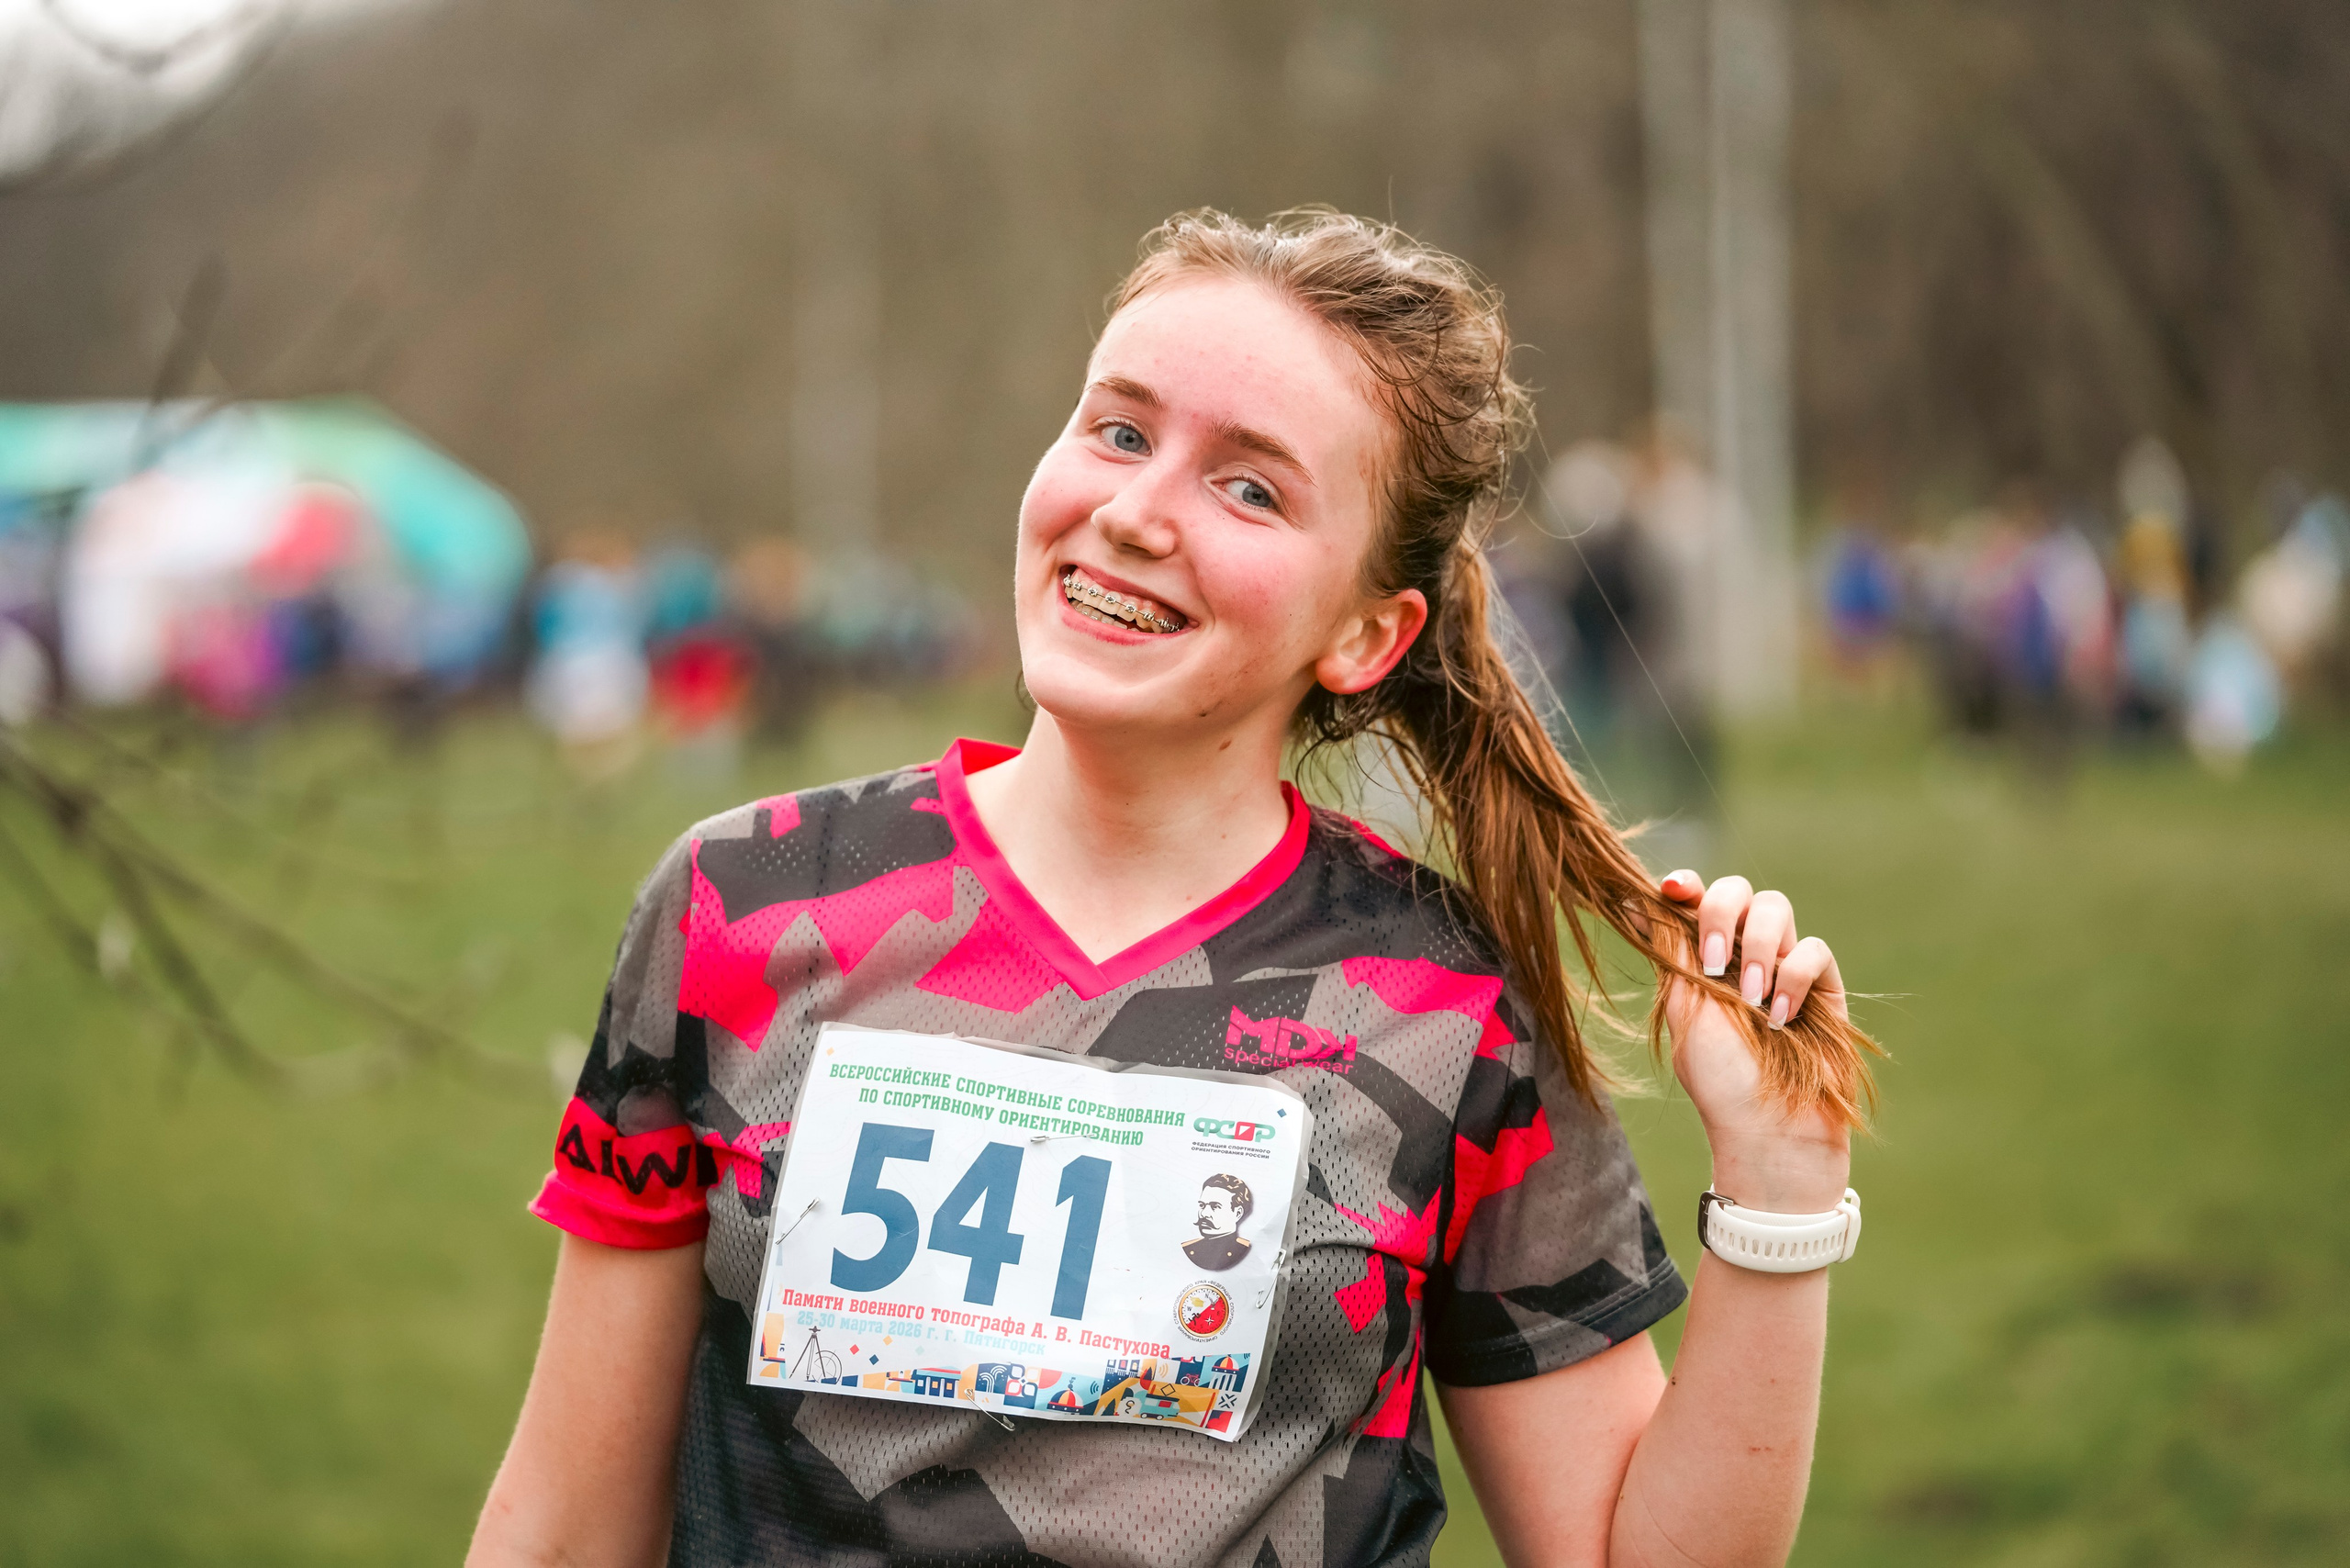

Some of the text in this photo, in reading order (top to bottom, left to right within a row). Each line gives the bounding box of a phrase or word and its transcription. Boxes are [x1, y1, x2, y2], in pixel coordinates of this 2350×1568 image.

[1224, 1047, 1354, 1075] special wear
[829, 1063, 1185, 1127] ВСЕРОССИЙСКИЕ СПОРТИВНЫЕ СОРЕВНОВАНИЯ
[858, 1087, 1144, 1146] ПО СПОРТИВНОМУ ОРИЕНТИРОВАНИЮ
[1191, 1146, 1245, 1156] ОРИЕНТИРОВАНИЯ
[1192, 1141, 1271, 1155] ФЕДЕРАЦИЯ СПОРТИВНОГО
[830, 1122, 1113, 1321] 541
[782, 1288, 1170, 1360] Памяти военного топографа А. В. Пастухова
[797, 1310, 1046, 1356] 25-30 марта 2026 г. г. Пятигорск
